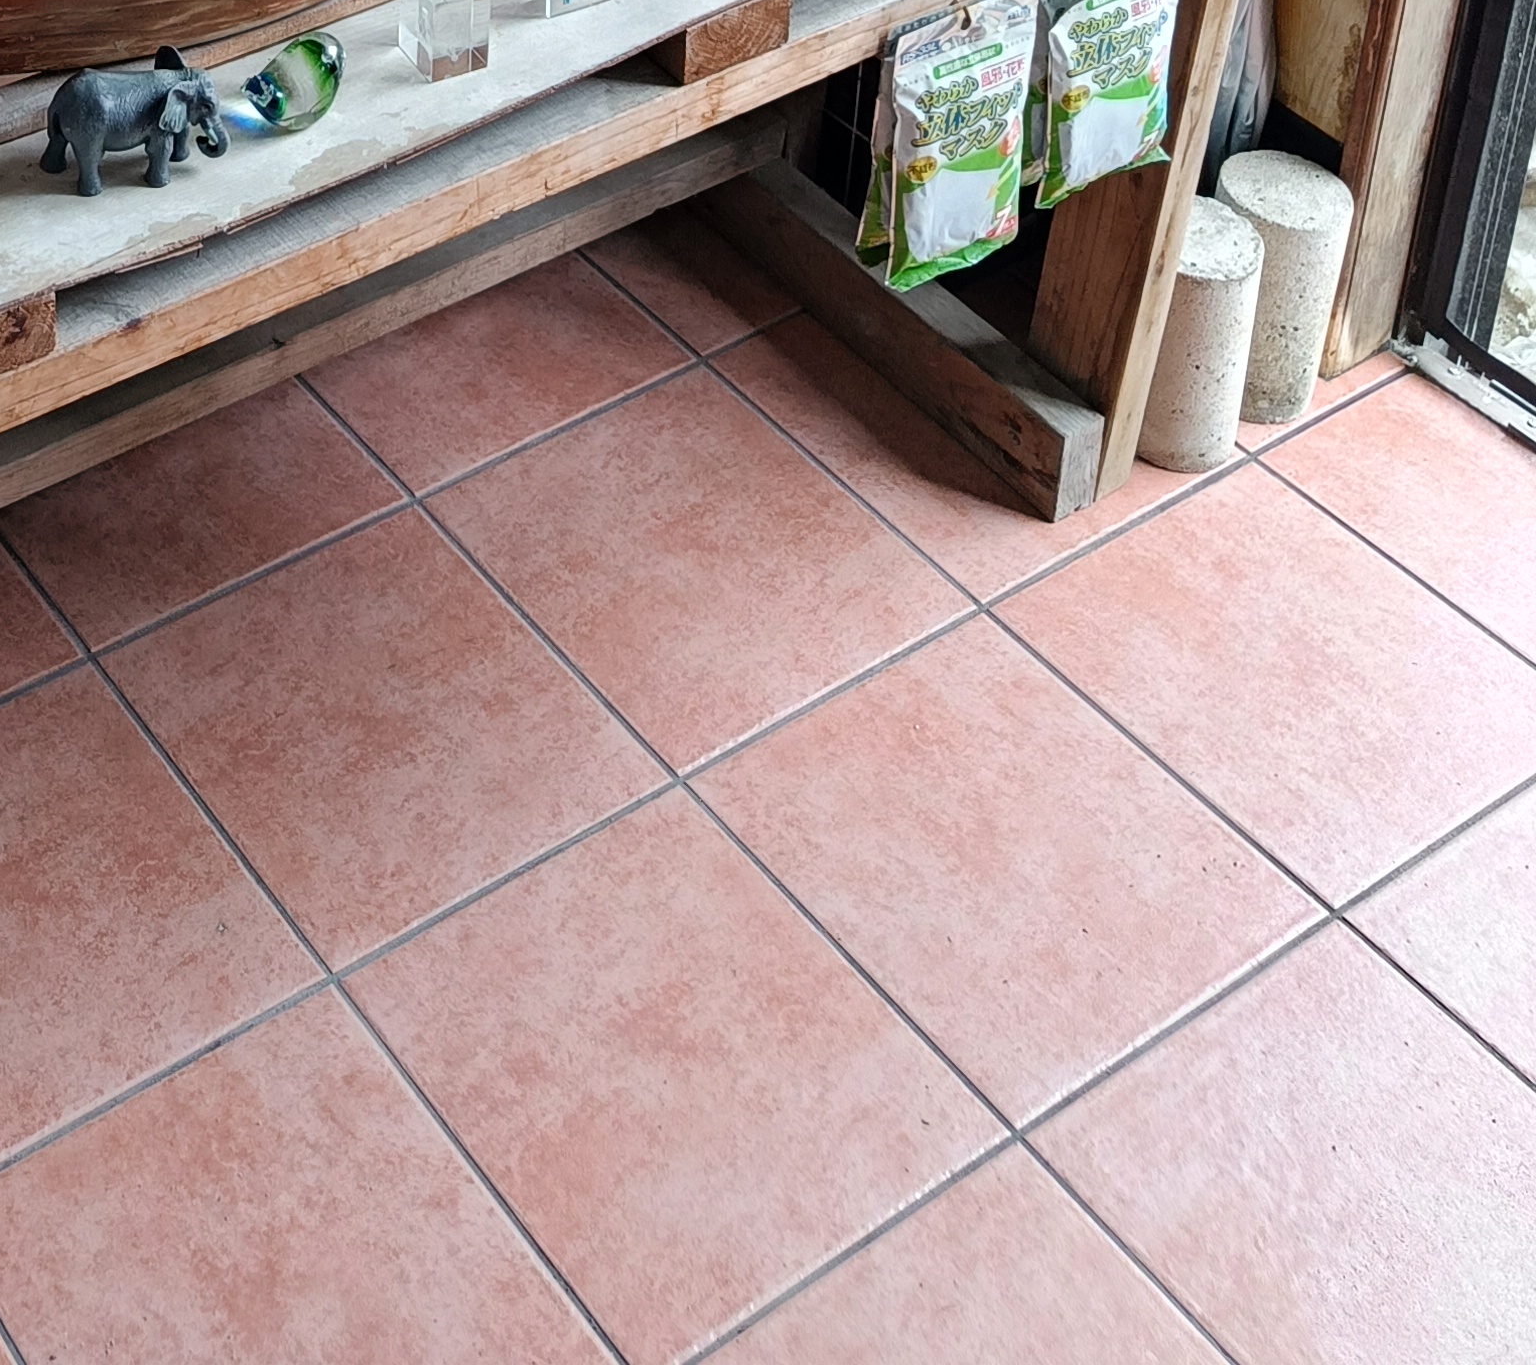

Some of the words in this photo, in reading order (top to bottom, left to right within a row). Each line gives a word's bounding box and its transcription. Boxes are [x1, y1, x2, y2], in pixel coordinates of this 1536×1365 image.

[1068, 7, 1128, 42] やわらか
[1092, 48, 1153, 89] マスク
[916, 75, 979, 113] やわらか
[939, 118, 1008, 161] マスク
